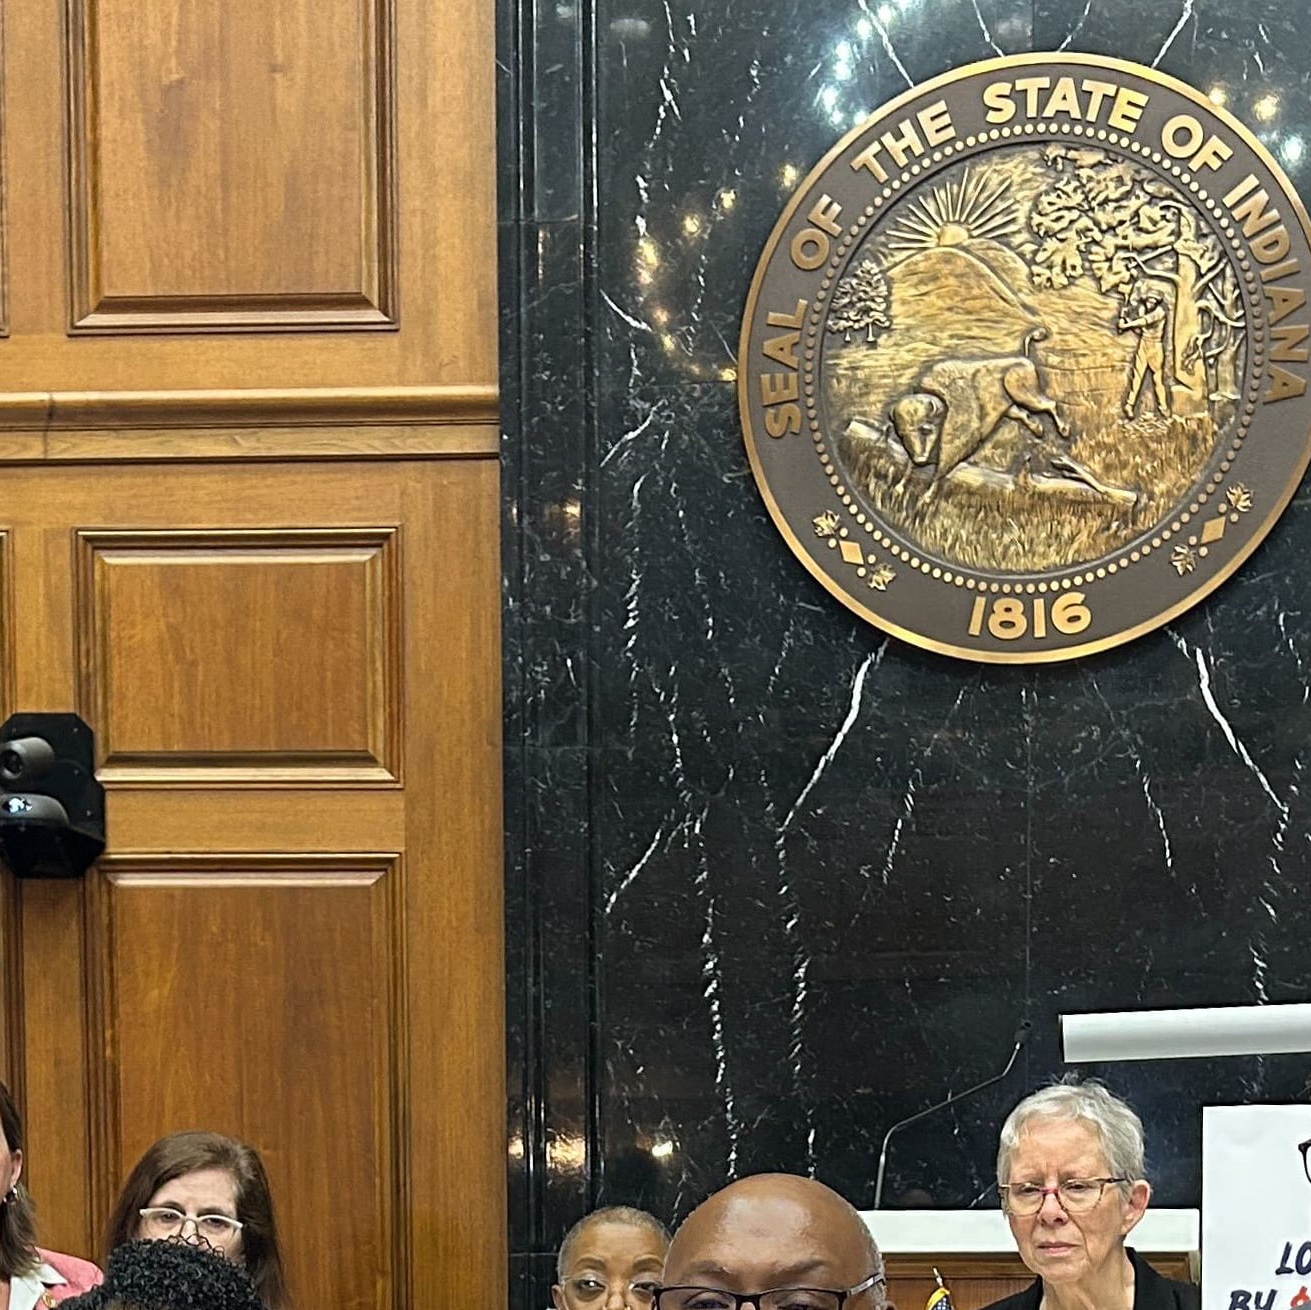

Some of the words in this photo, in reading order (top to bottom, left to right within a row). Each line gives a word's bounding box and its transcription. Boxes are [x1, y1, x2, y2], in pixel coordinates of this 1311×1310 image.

[760, 297, 809, 439] SEAL
[790, 193, 844, 271] OF
[850, 99, 957, 186] THE
[982, 75, 1149, 134] STATE
[1160, 114, 1233, 176] OF
[1221, 173, 1311, 406] INDIANA
[967, 591, 1093, 640] 1816
